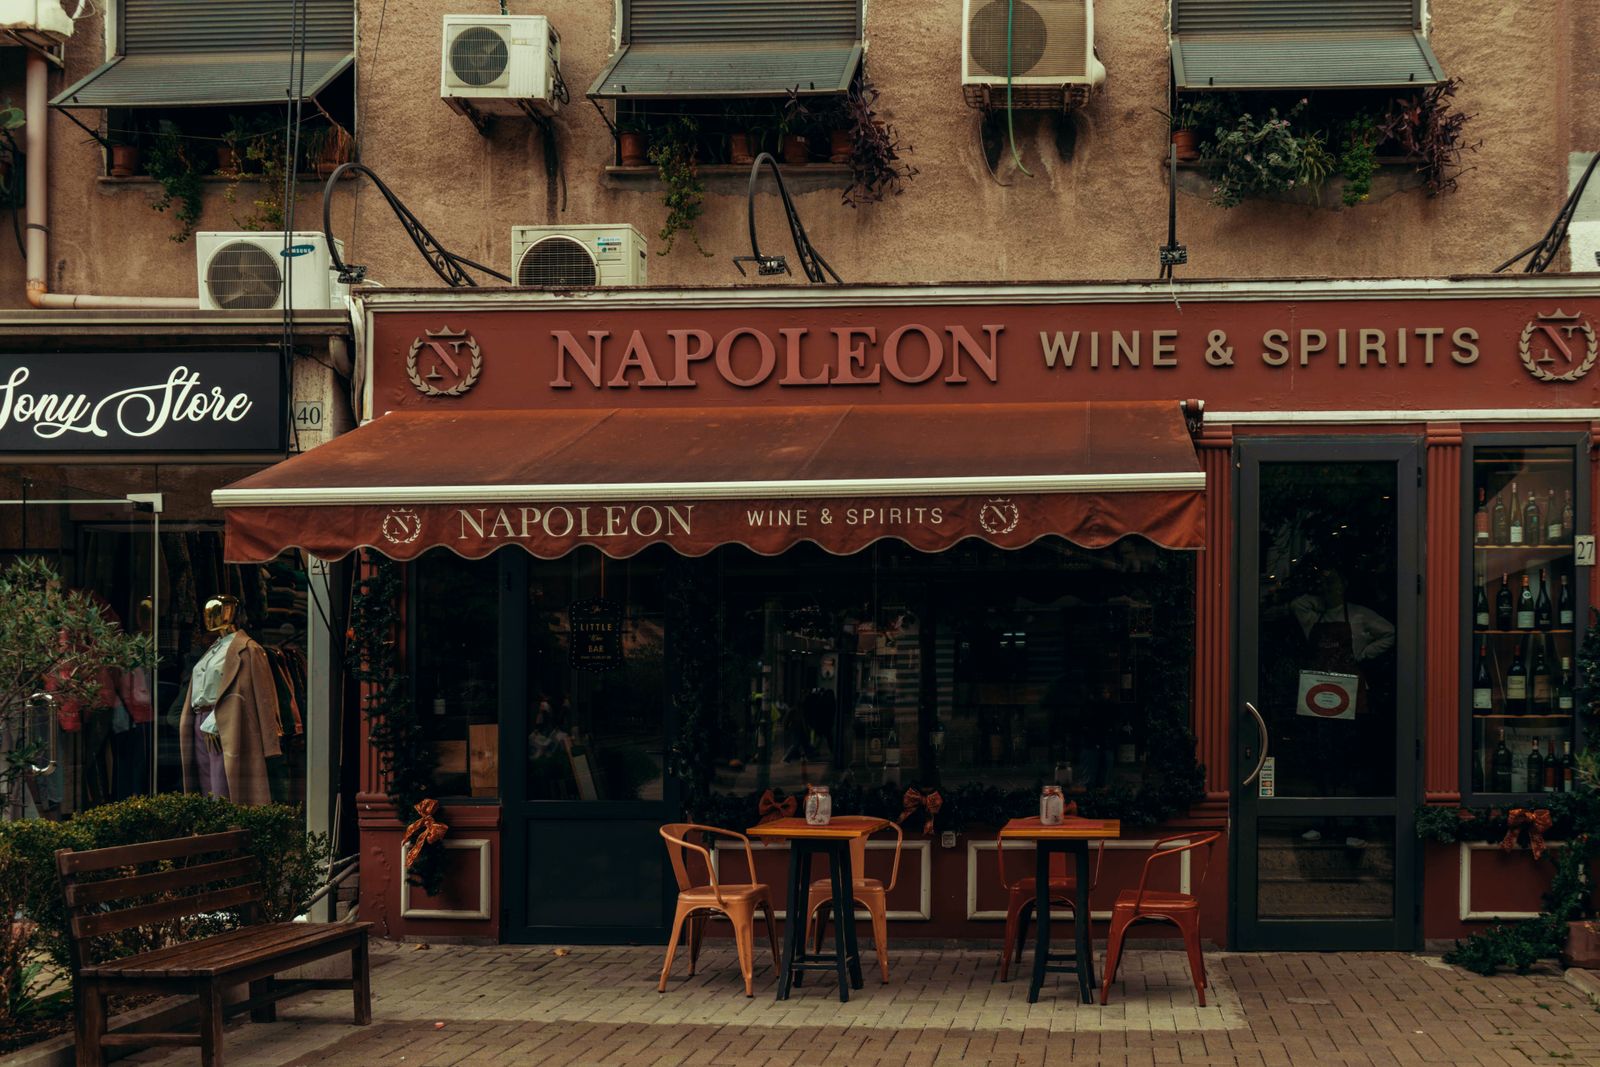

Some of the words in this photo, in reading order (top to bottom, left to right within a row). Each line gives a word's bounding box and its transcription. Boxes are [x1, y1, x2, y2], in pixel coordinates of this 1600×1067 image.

[550, 324, 1004, 388] NAPOLEON
[1039, 329, 1179, 368] WINE
[1205, 328, 1234, 366] &
[1261, 327, 1480, 366] SPIRITS
[91, 365, 253, 438] Store
[297, 406, 320, 425] 40
[458, 504, 695, 539] NAPOLEON
[747, 509, 808, 527] WINE
[820, 508, 833, 524] &
[846, 507, 944, 525] SPIRITS
[1577, 541, 1594, 560] 27
